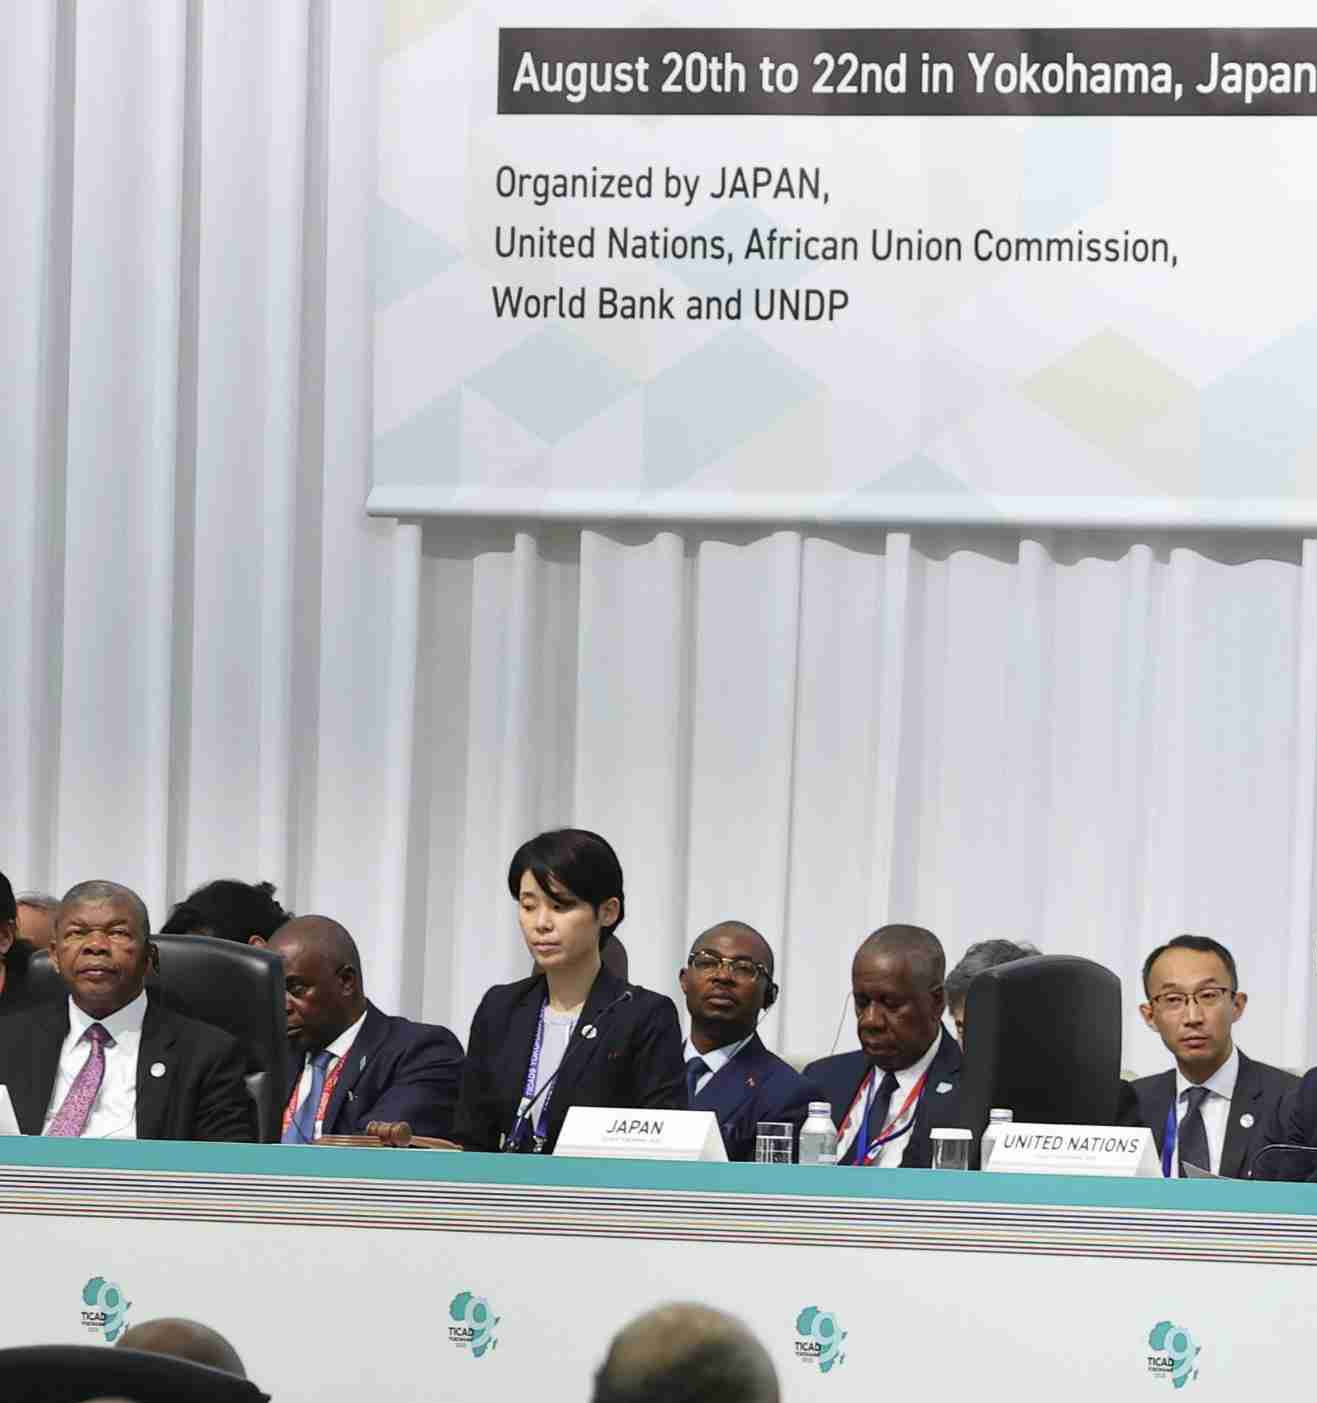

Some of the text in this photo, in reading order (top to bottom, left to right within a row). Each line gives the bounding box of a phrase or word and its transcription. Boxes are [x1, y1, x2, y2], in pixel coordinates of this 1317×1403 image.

[512, 51, 1317, 104] August 20th to 22nd in Yokohama, Japan
[496, 165, 829, 207] Organized by JAPAN,
[495, 226, 1177, 267] United Nations, African Union Commission,
[492, 286, 849, 321] World Bank and UNDP
[606, 1119, 665, 1135] JAPAN
[1003, 1135, 1140, 1153] UNITED NATIONS
[1148, 1357, 1175, 1367] TICAD
